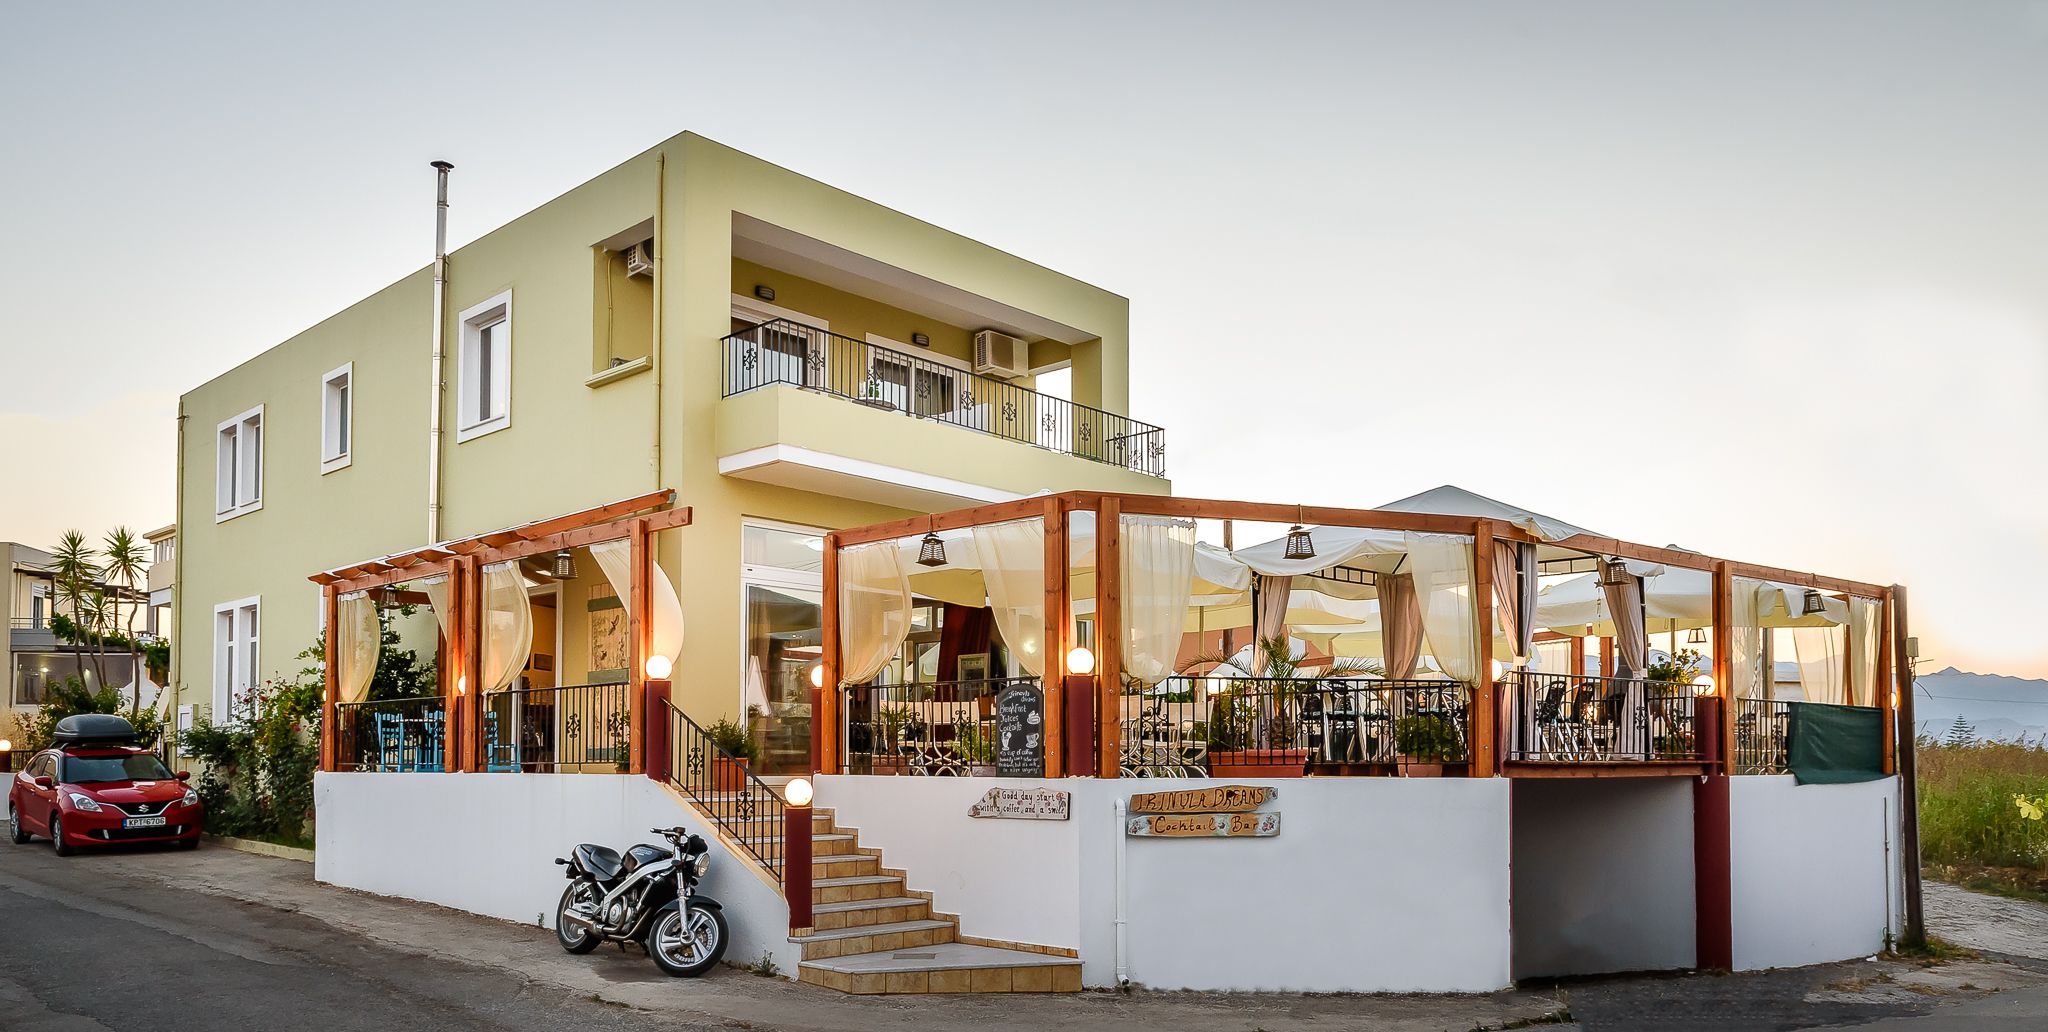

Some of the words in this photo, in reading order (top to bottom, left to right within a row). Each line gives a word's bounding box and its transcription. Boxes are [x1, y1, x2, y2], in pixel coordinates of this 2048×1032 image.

[1002, 790, 1018, 800] Good
[1021, 790, 1033, 805] day
[1036, 791, 1055, 802] start
[1212, 787, 1264, 810] DREAMS
[979, 803, 994, 812] with
[1024, 803, 1036, 814] and
[1154, 815, 1217, 834] Cocktail
[1231, 815, 1258, 833] Bar
